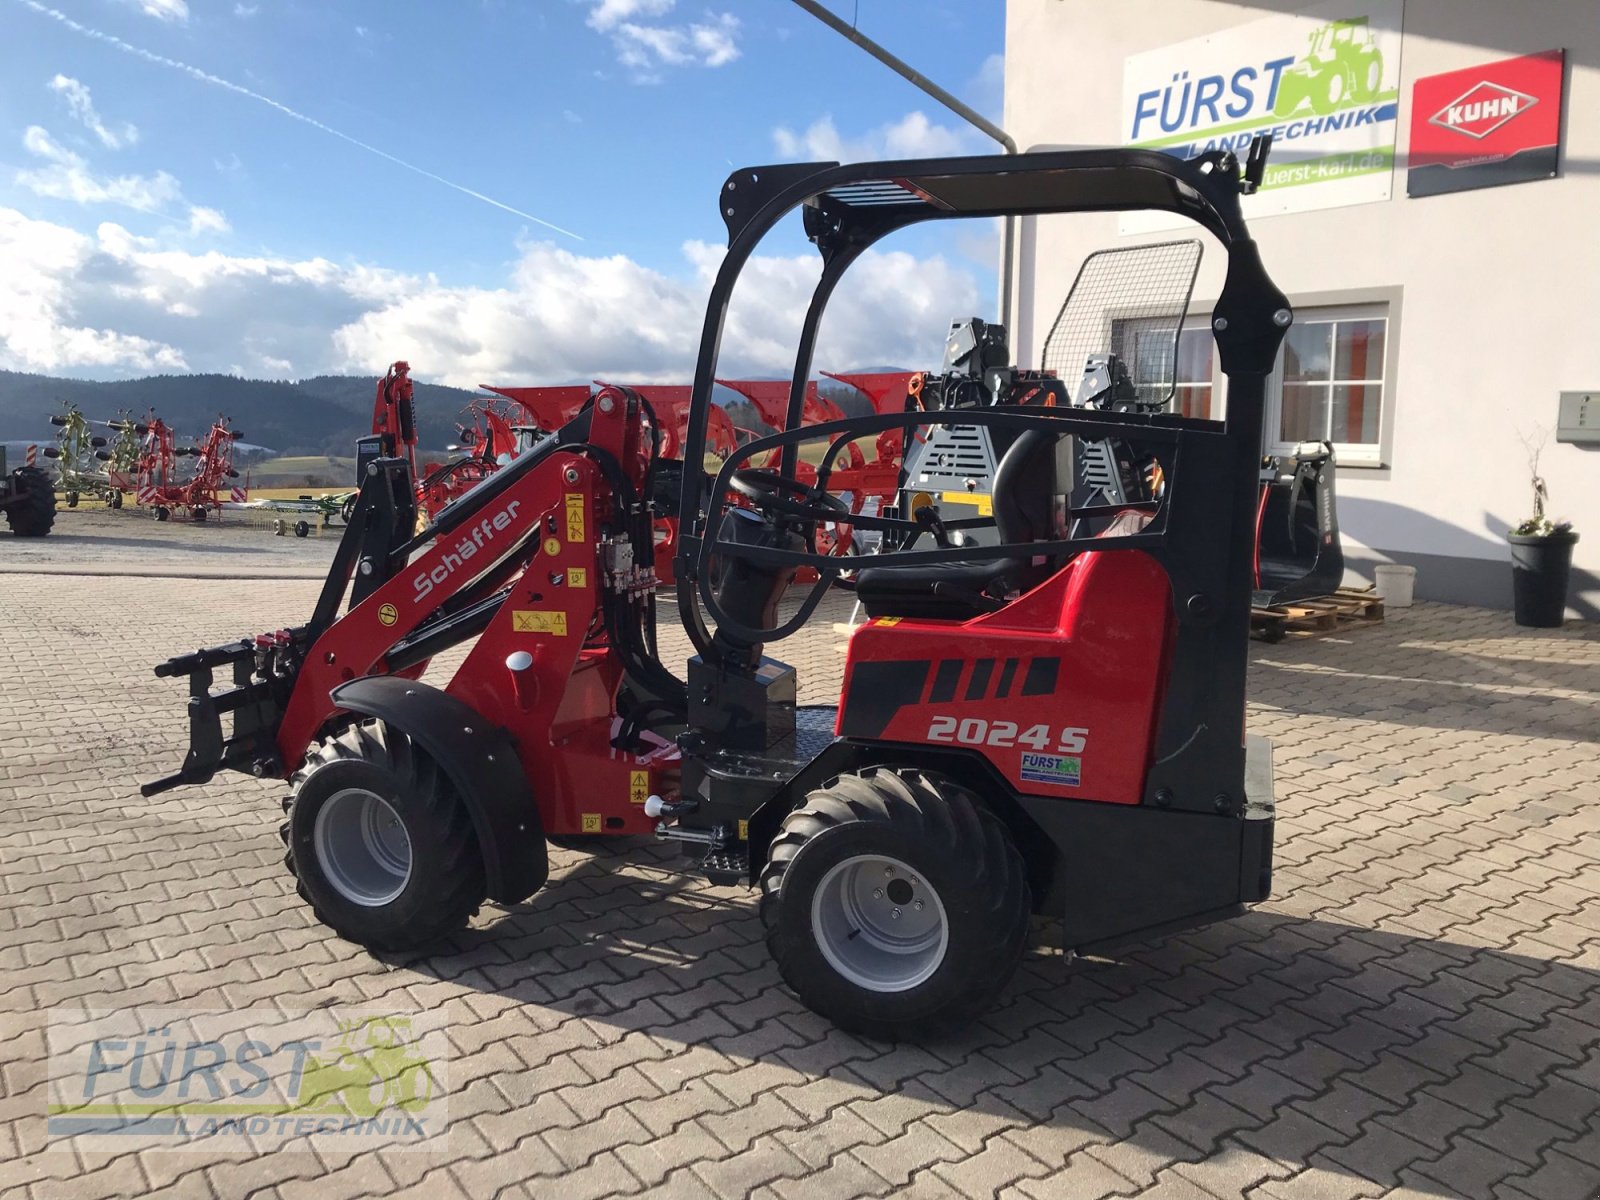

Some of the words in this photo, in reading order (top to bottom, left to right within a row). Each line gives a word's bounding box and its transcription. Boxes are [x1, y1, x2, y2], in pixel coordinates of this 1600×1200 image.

[1131, 55, 1295, 140] FÜRST
[1447, 95, 1518, 125] KUHN
[413, 500, 520, 604] Schäffer
[927, 715, 1050, 750] 2024
[1058, 727, 1089, 753] S
[1022, 753, 1063, 769] FÜRST
